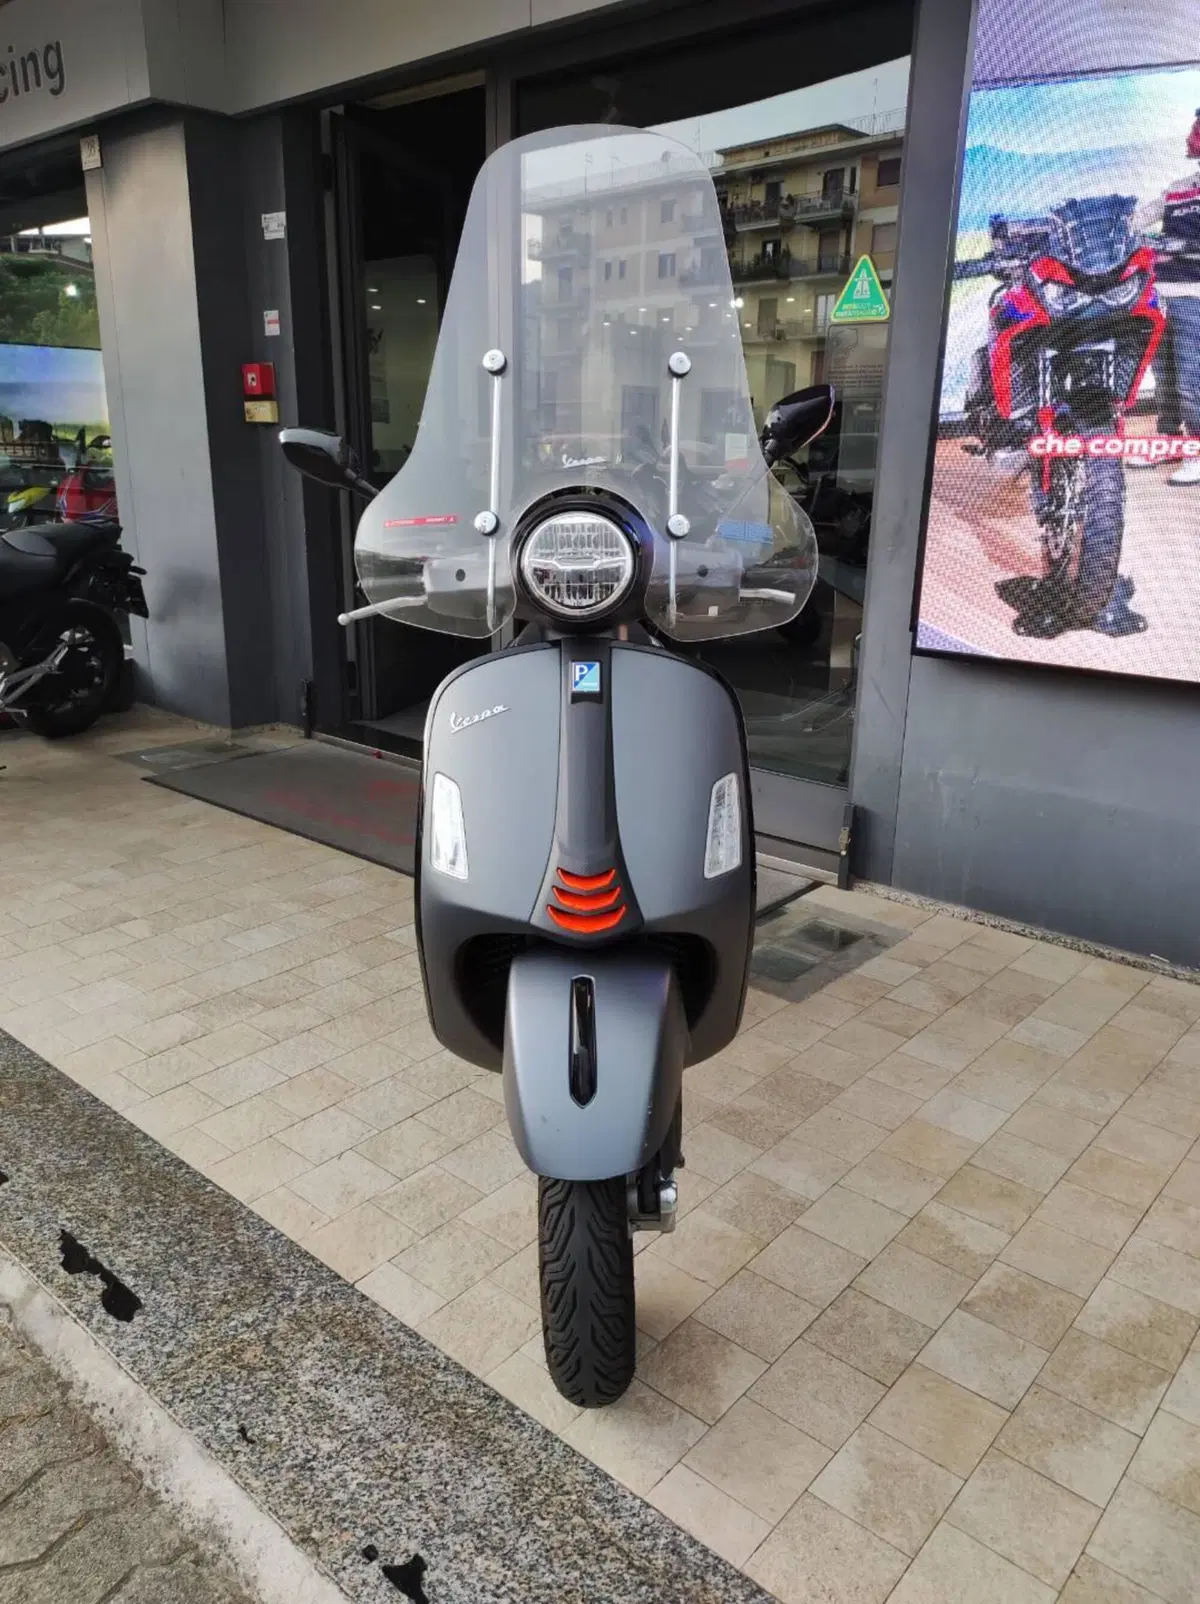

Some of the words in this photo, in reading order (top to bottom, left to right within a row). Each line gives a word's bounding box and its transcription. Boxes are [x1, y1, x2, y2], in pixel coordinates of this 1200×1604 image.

[1030, 434, 1082, 455] che
[1090, 437, 1200, 459] compre
[562, 453, 607, 468] Vespa
[575, 664, 588, 681] P
[450, 704, 509, 734] Vespa
